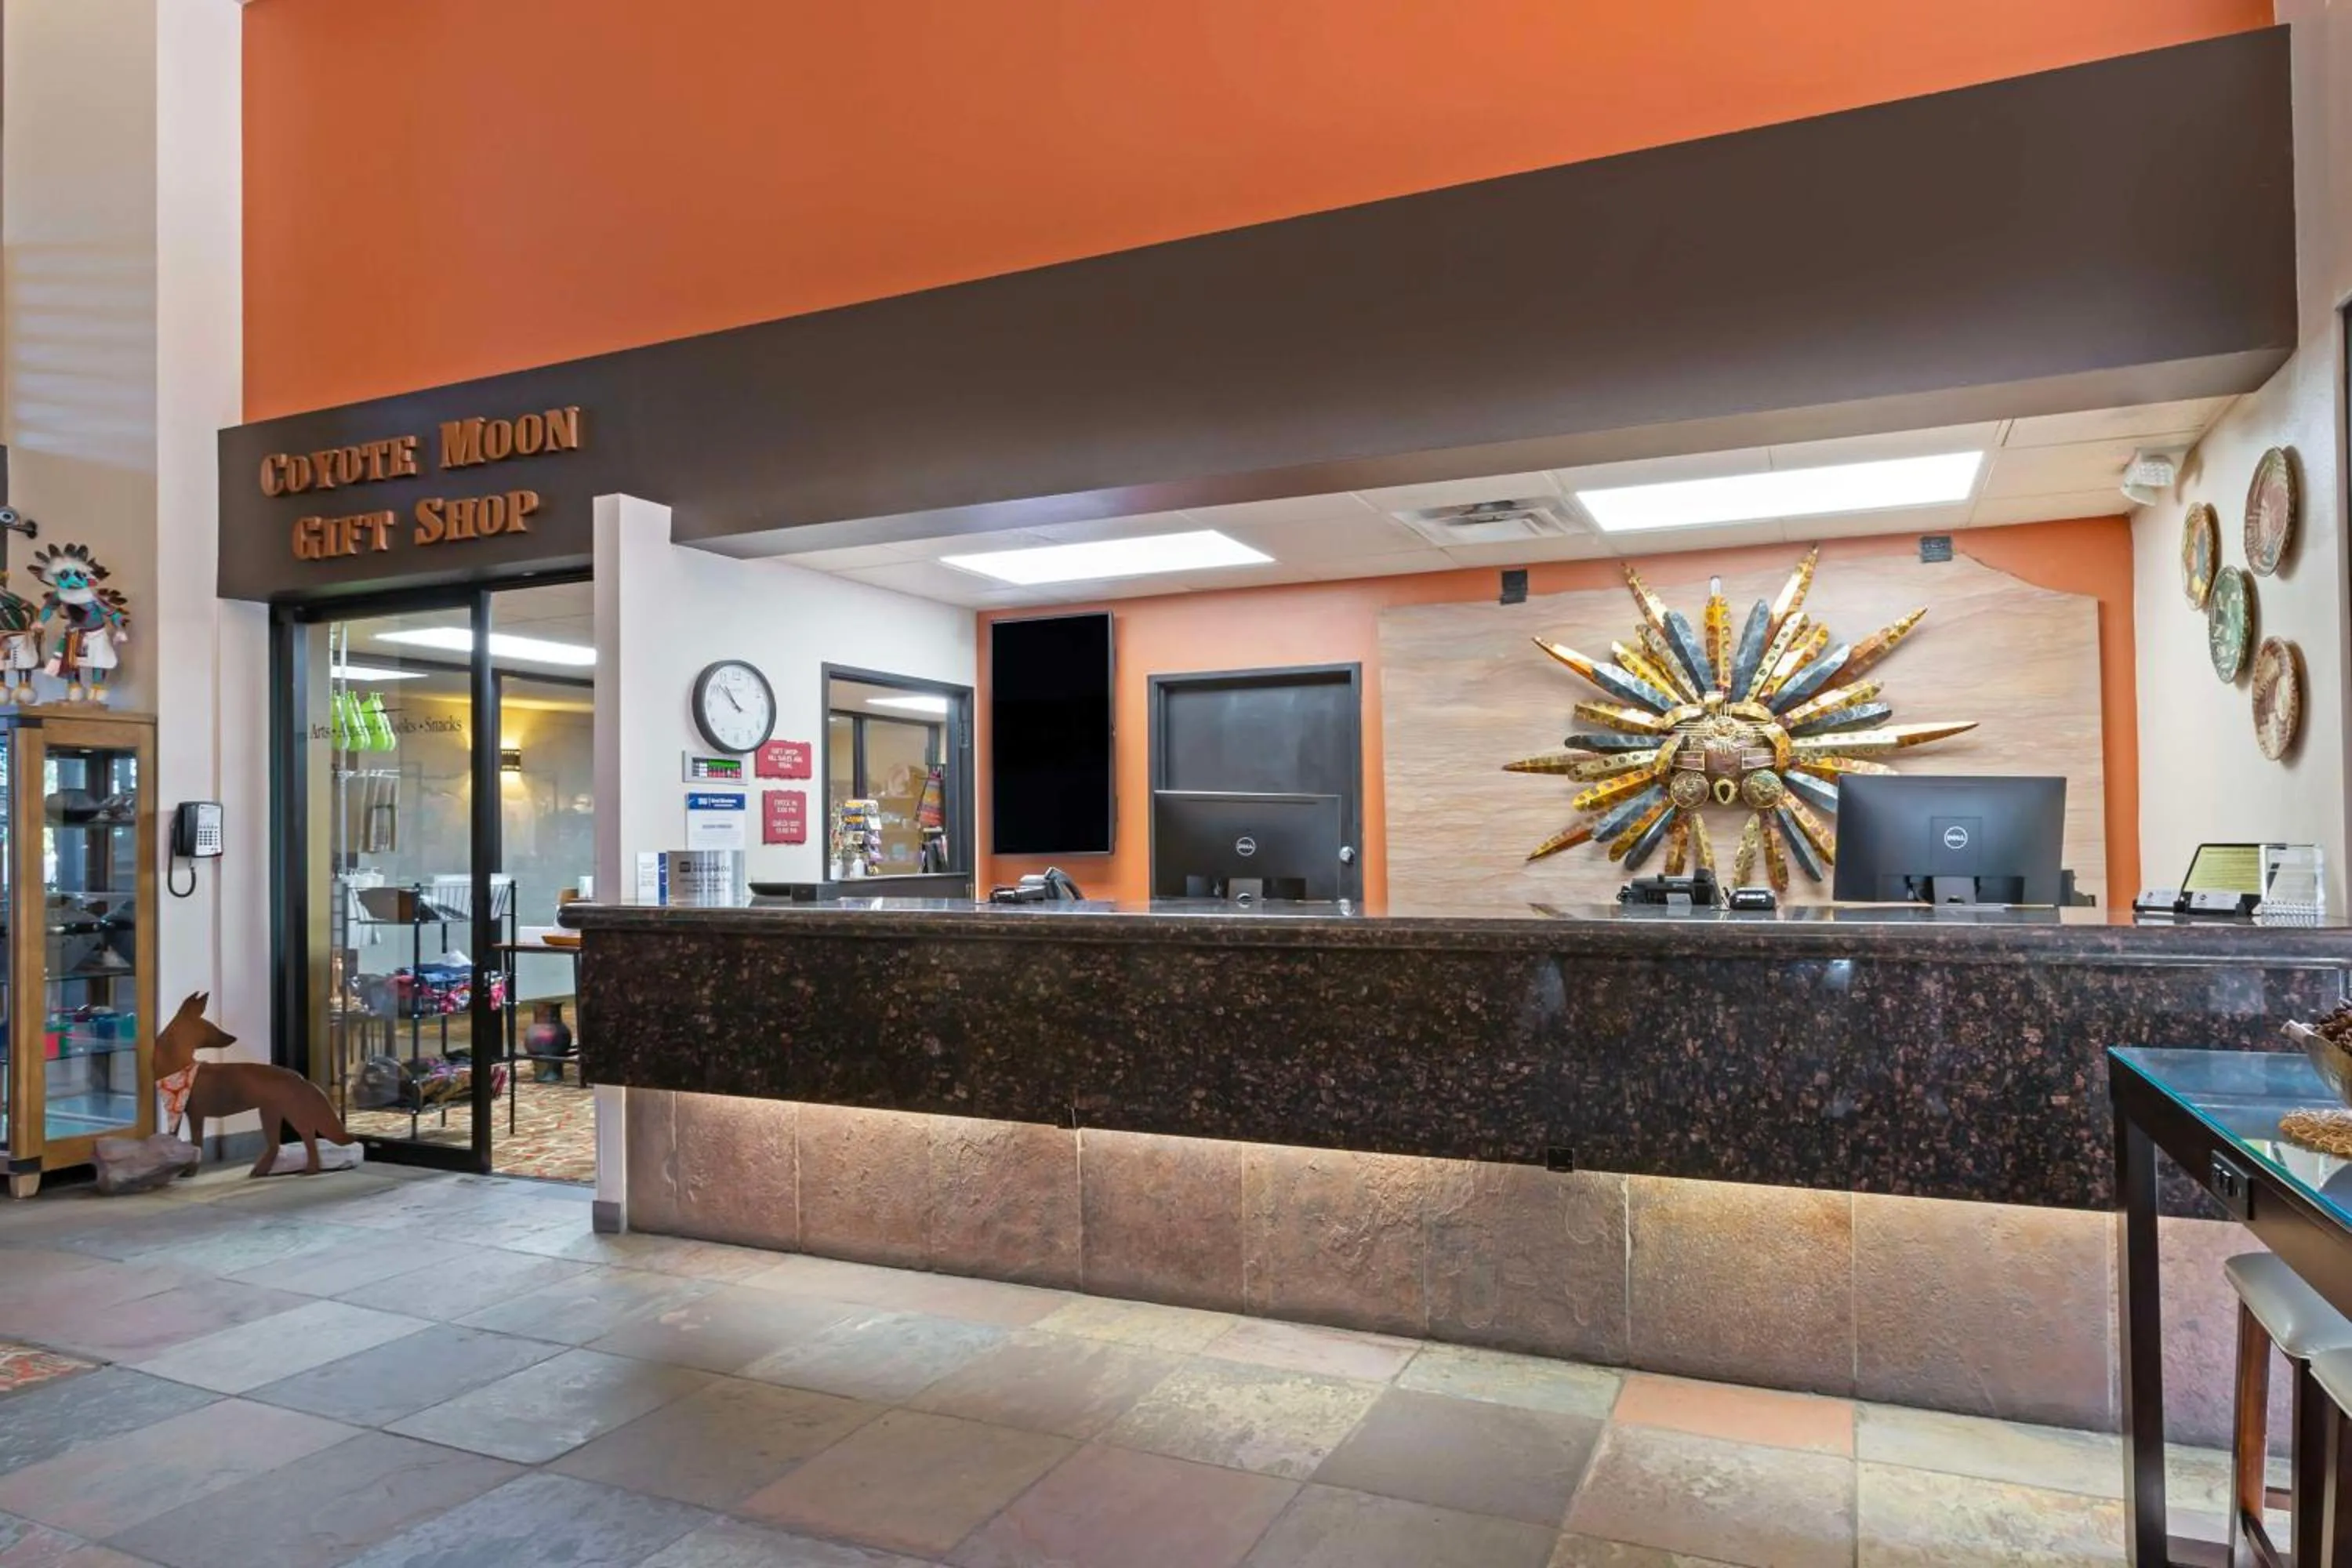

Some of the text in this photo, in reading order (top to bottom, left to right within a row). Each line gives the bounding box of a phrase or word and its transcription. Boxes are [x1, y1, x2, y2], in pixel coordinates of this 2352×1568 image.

[260, 406, 579, 497] COYOTE MOON
[293, 490, 539, 560] GIFT SHOP
[311, 723, 330, 739] Arts
[425, 715, 463, 732] Snacks
